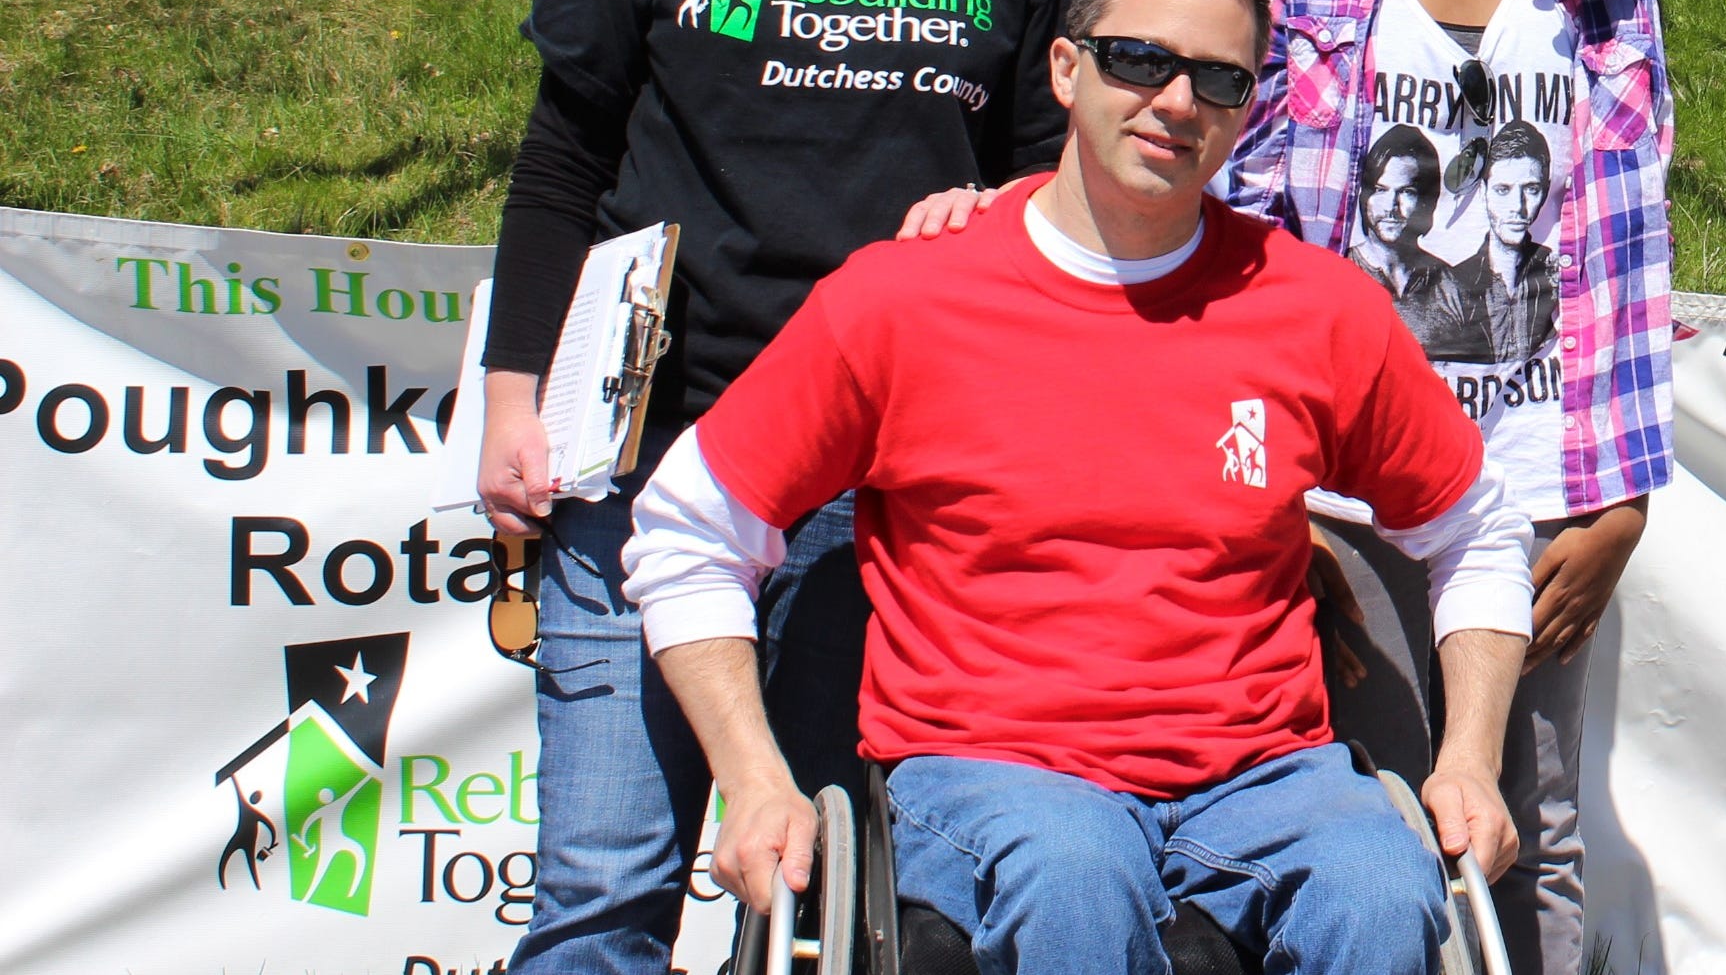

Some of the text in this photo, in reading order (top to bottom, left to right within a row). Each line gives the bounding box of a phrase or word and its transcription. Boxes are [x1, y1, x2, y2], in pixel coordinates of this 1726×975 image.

[761, 60, 990, 111] Dutchess County
[117, 256, 474, 323] This Hou
